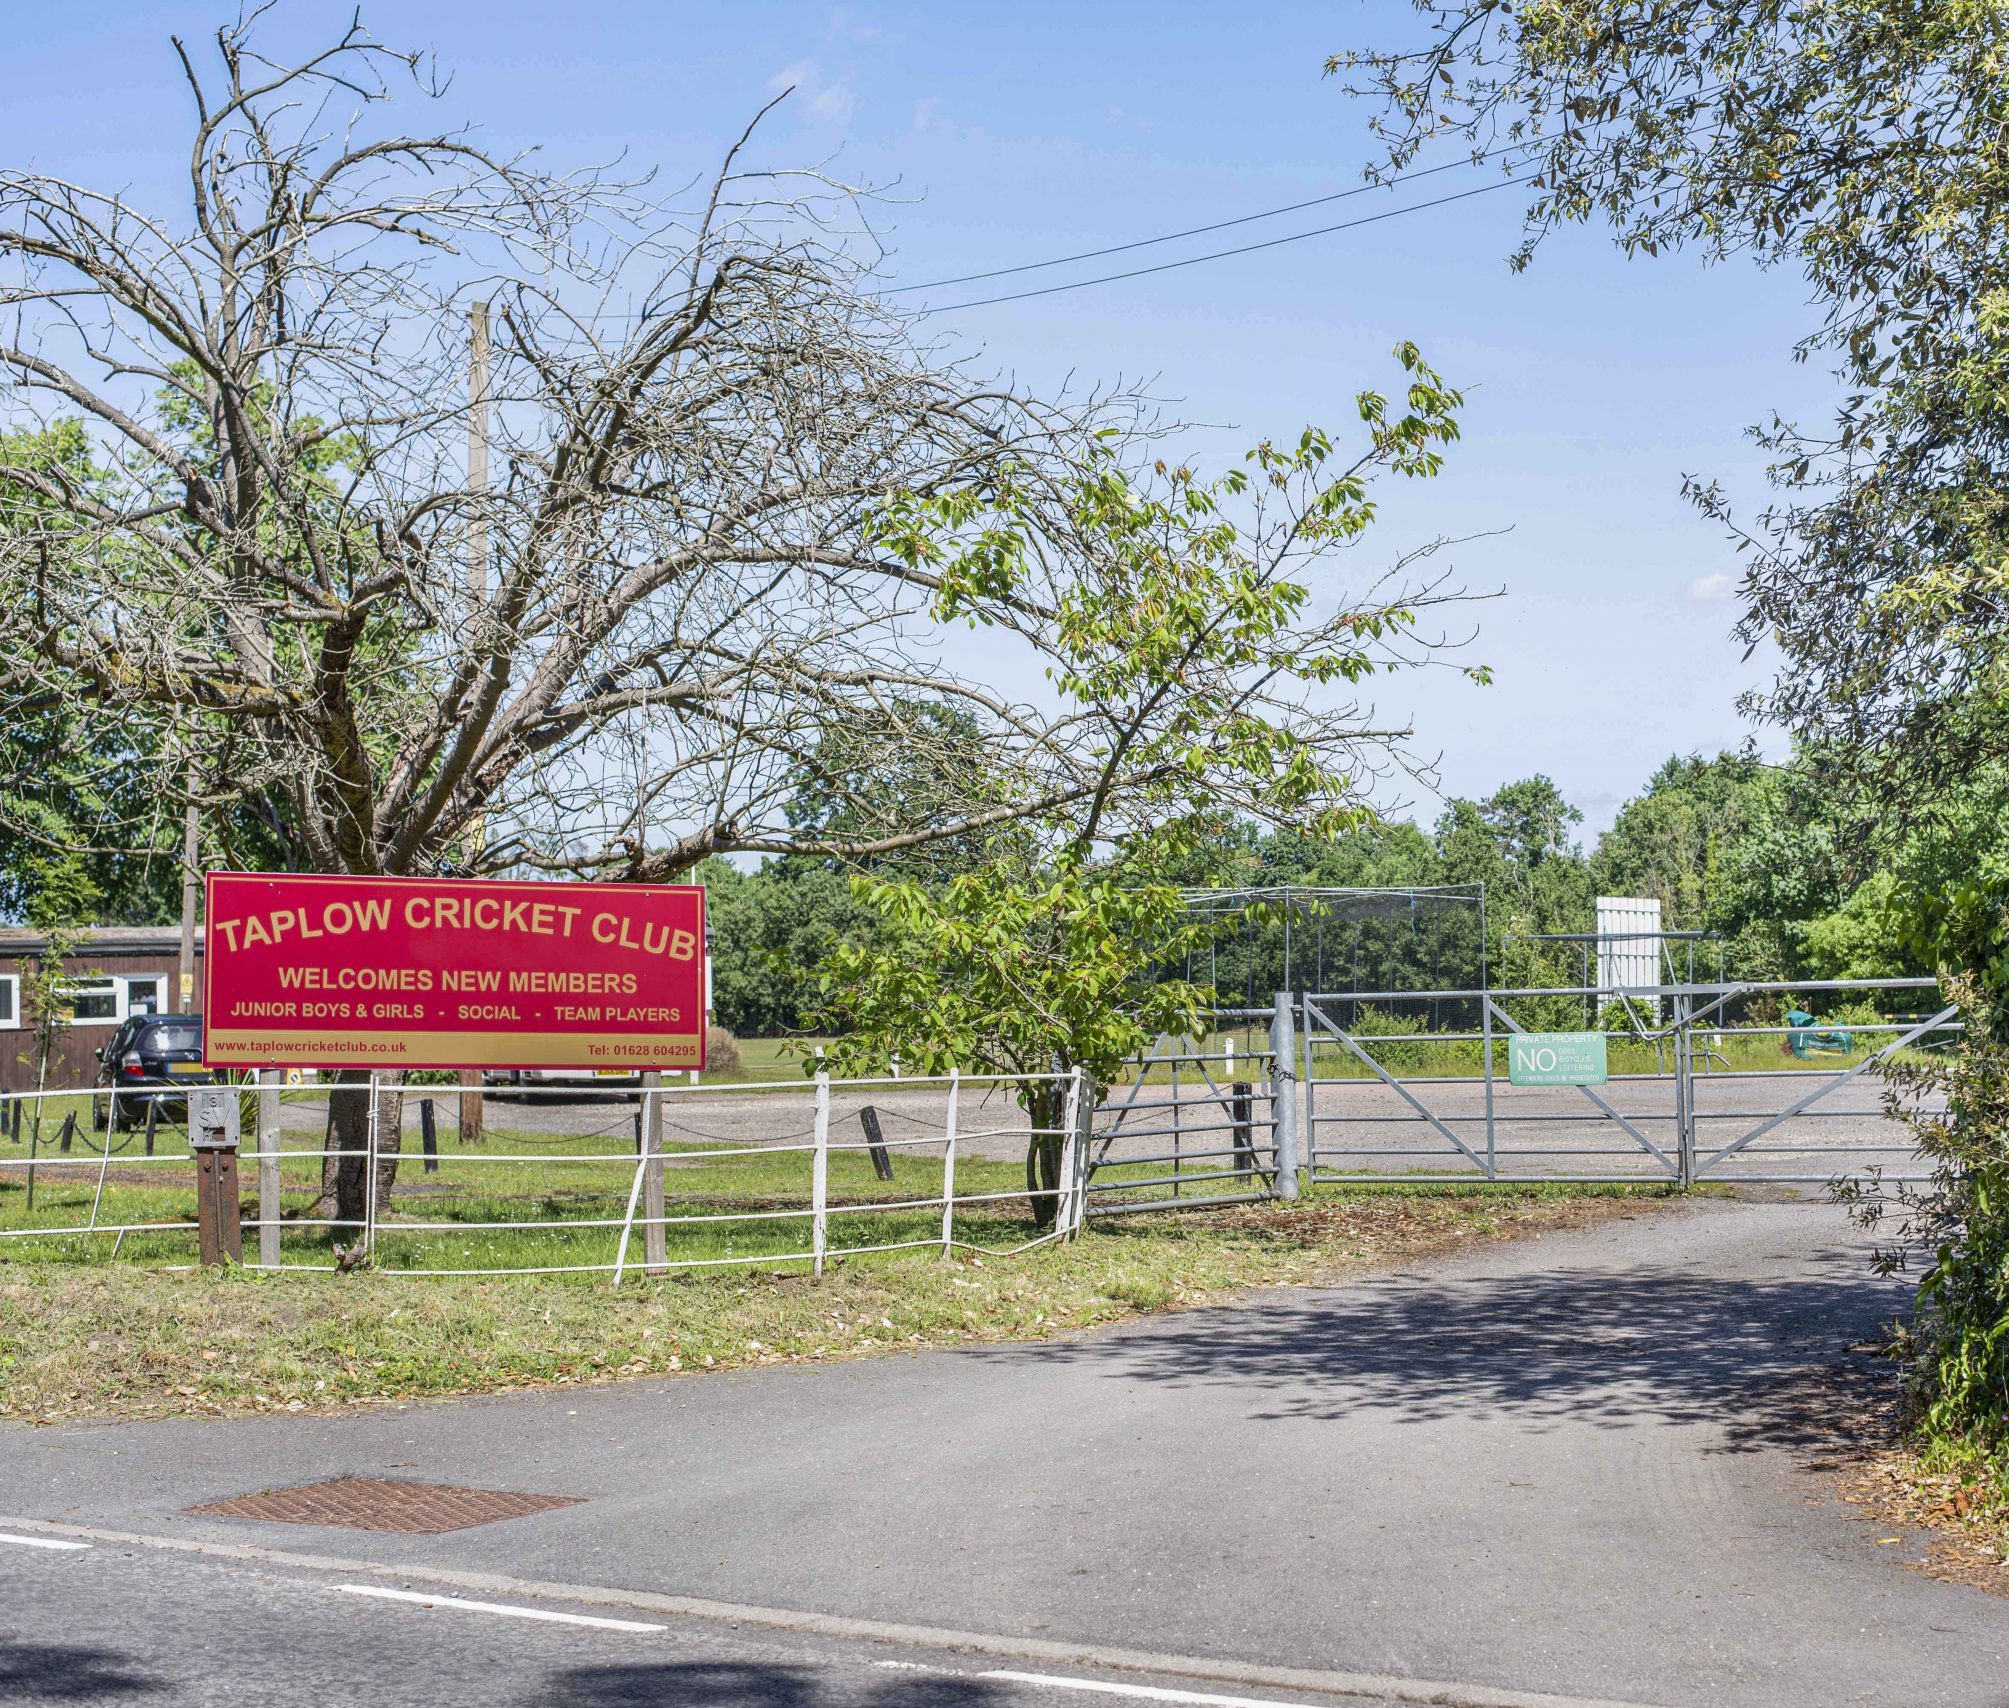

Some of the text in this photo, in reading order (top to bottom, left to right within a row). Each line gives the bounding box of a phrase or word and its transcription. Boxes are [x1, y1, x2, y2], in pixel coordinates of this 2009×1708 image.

[215, 897, 697, 962] TAPLOW CRICKET CLUB
[278, 967, 639, 995] WELCOMES NEW MEMBERS
[230, 1001, 298, 1018] JUNIOR
[302, 1002, 351, 1019] BOYS
[355, 1003, 369, 1019] &
[372, 1004, 425, 1020] GIRLS
[458, 1004, 521, 1021] SOCIAL
[553, 1006, 601, 1022] TEAM
[605, 1007, 681, 1023] PLAYERS
[214, 1040, 408, 1054] www.taplowcricketclub.co.uk
[1515, 1034, 1598, 1044] PRIVATE PROPERTY
[587, 1044, 697, 1057] Tel: 01628 604295
[1558, 1055, 1591, 1063] BICYCLES
[1517, 1048, 1557, 1072] NO
[1559, 1064, 1595, 1072] LOITERING
[198, 1108, 231, 1129] SV
